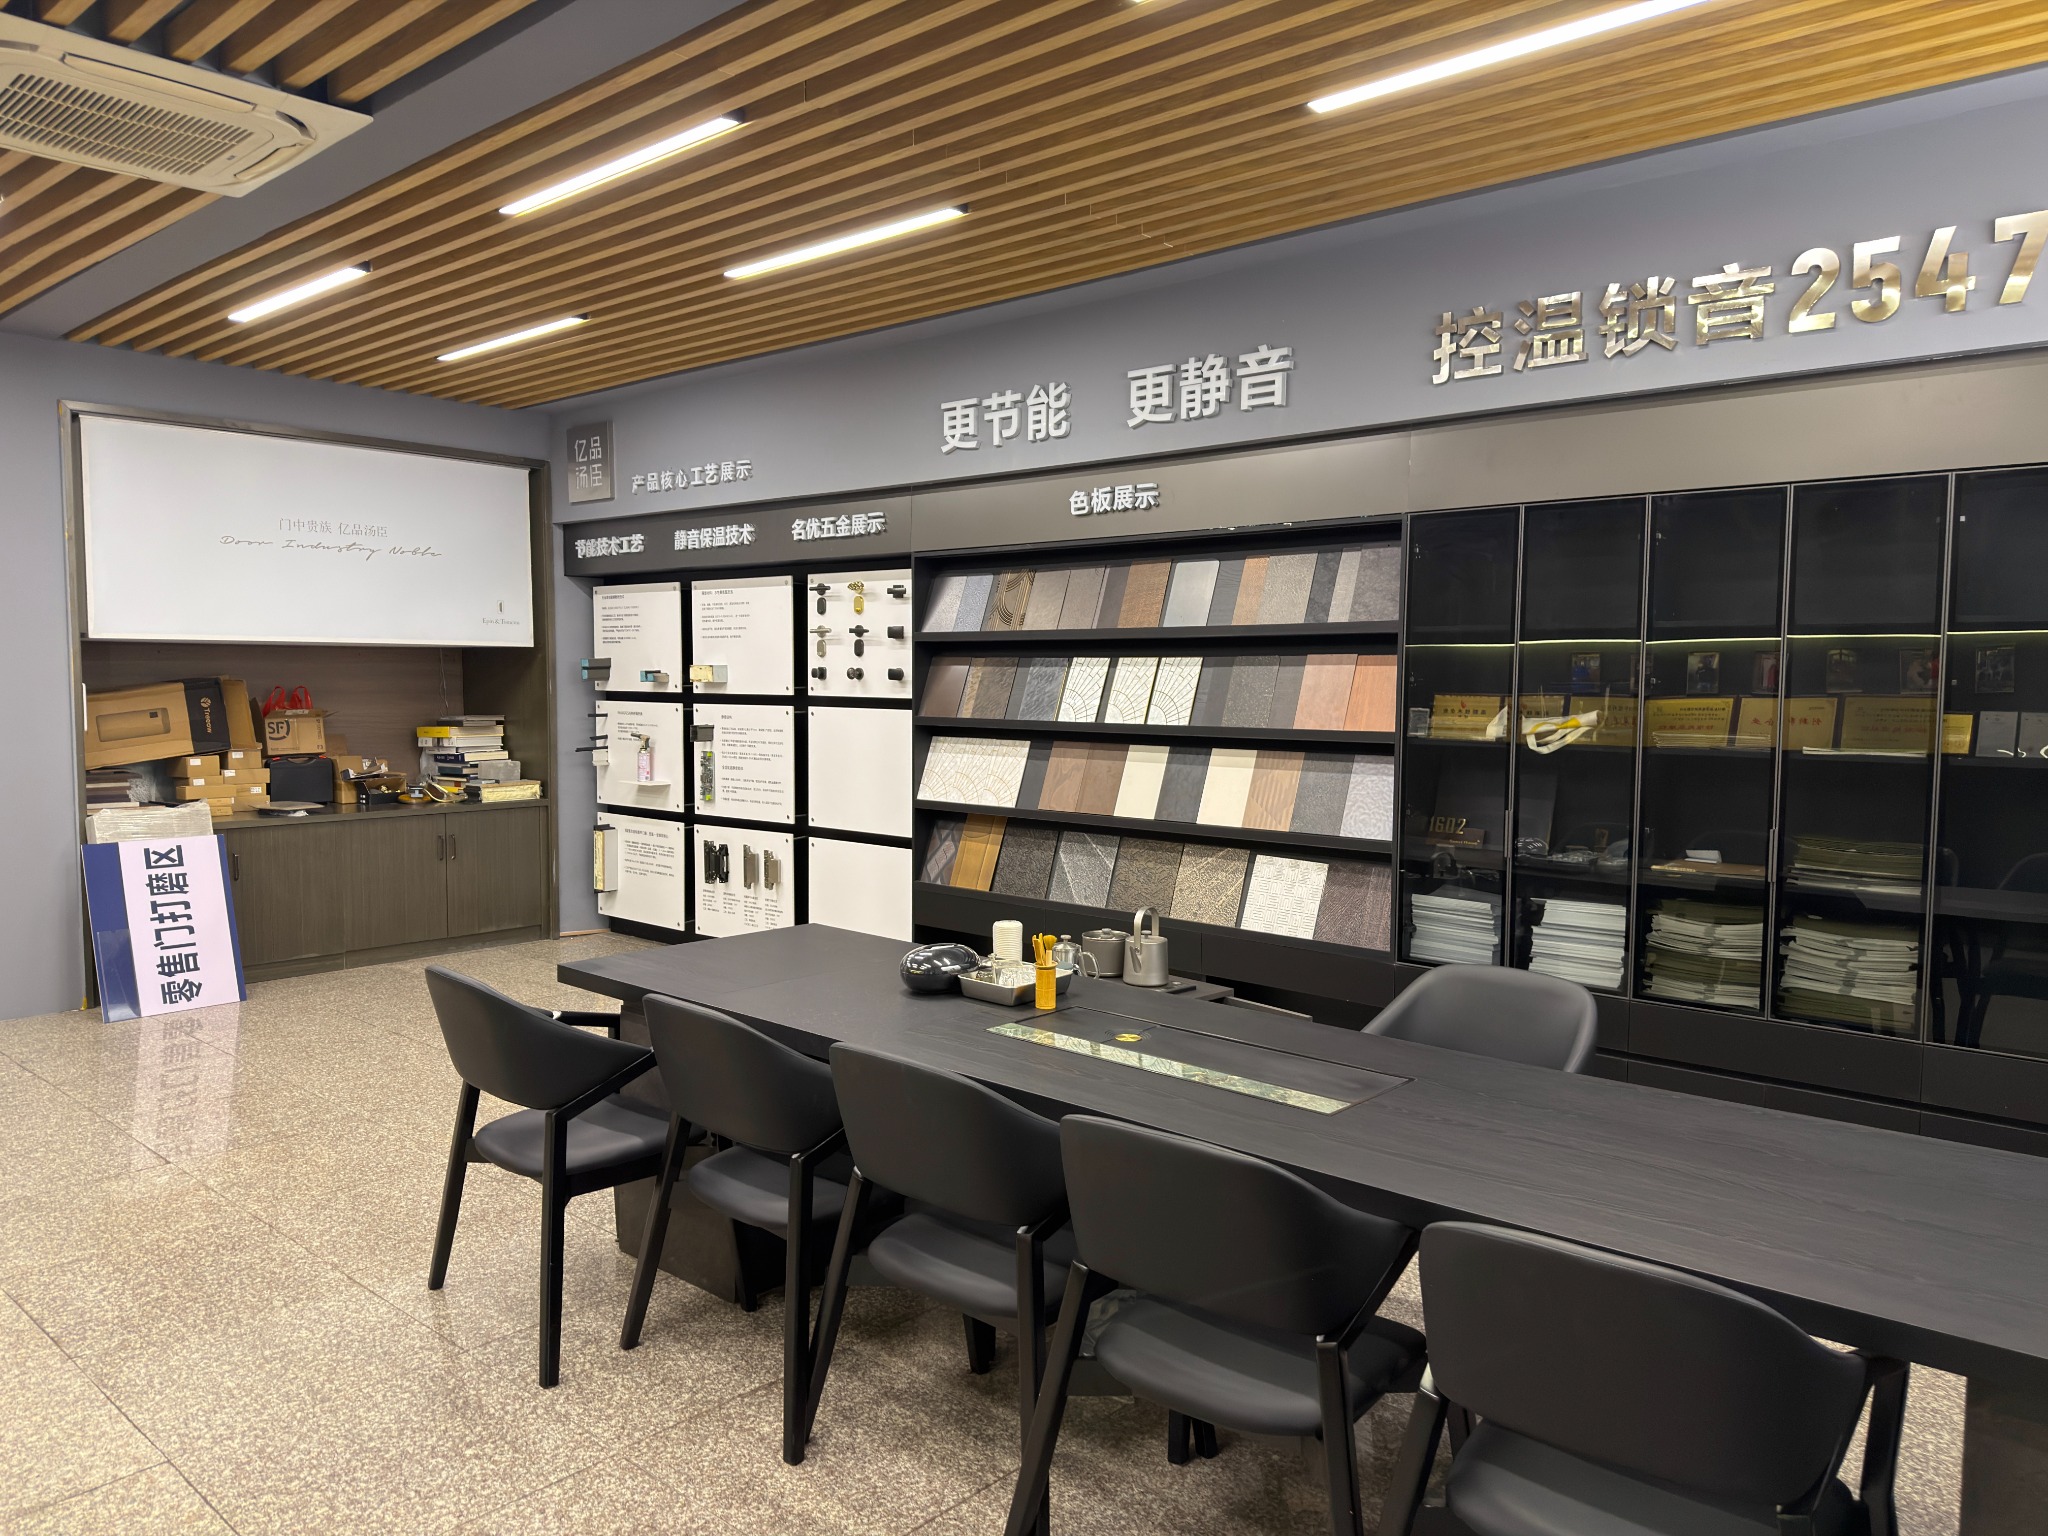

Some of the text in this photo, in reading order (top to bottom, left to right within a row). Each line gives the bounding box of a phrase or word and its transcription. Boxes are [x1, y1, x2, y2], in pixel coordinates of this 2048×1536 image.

[1431, 209, 2048, 386] 控温锁音2547
[940, 344, 1295, 455] 更节能 更静音
[574, 436, 603, 462] 亿品
[574, 464, 604, 490] 汤臣
[631, 459, 753, 496] 产品核心工艺展示
[1069, 482, 1160, 516] 色板展示
[279, 517, 388, 539] 门中贵族 亿品汤臣
[575, 511, 887, 560] 节能技术工艺 静音保温技术 名优五金展示
[219, 535, 443, 561] Door Industry Noble
[267, 721, 285, 735] SF
[1429, 816, 1467, 835] 1602
[143, 844, 204, 1006] 零售门打磨区
